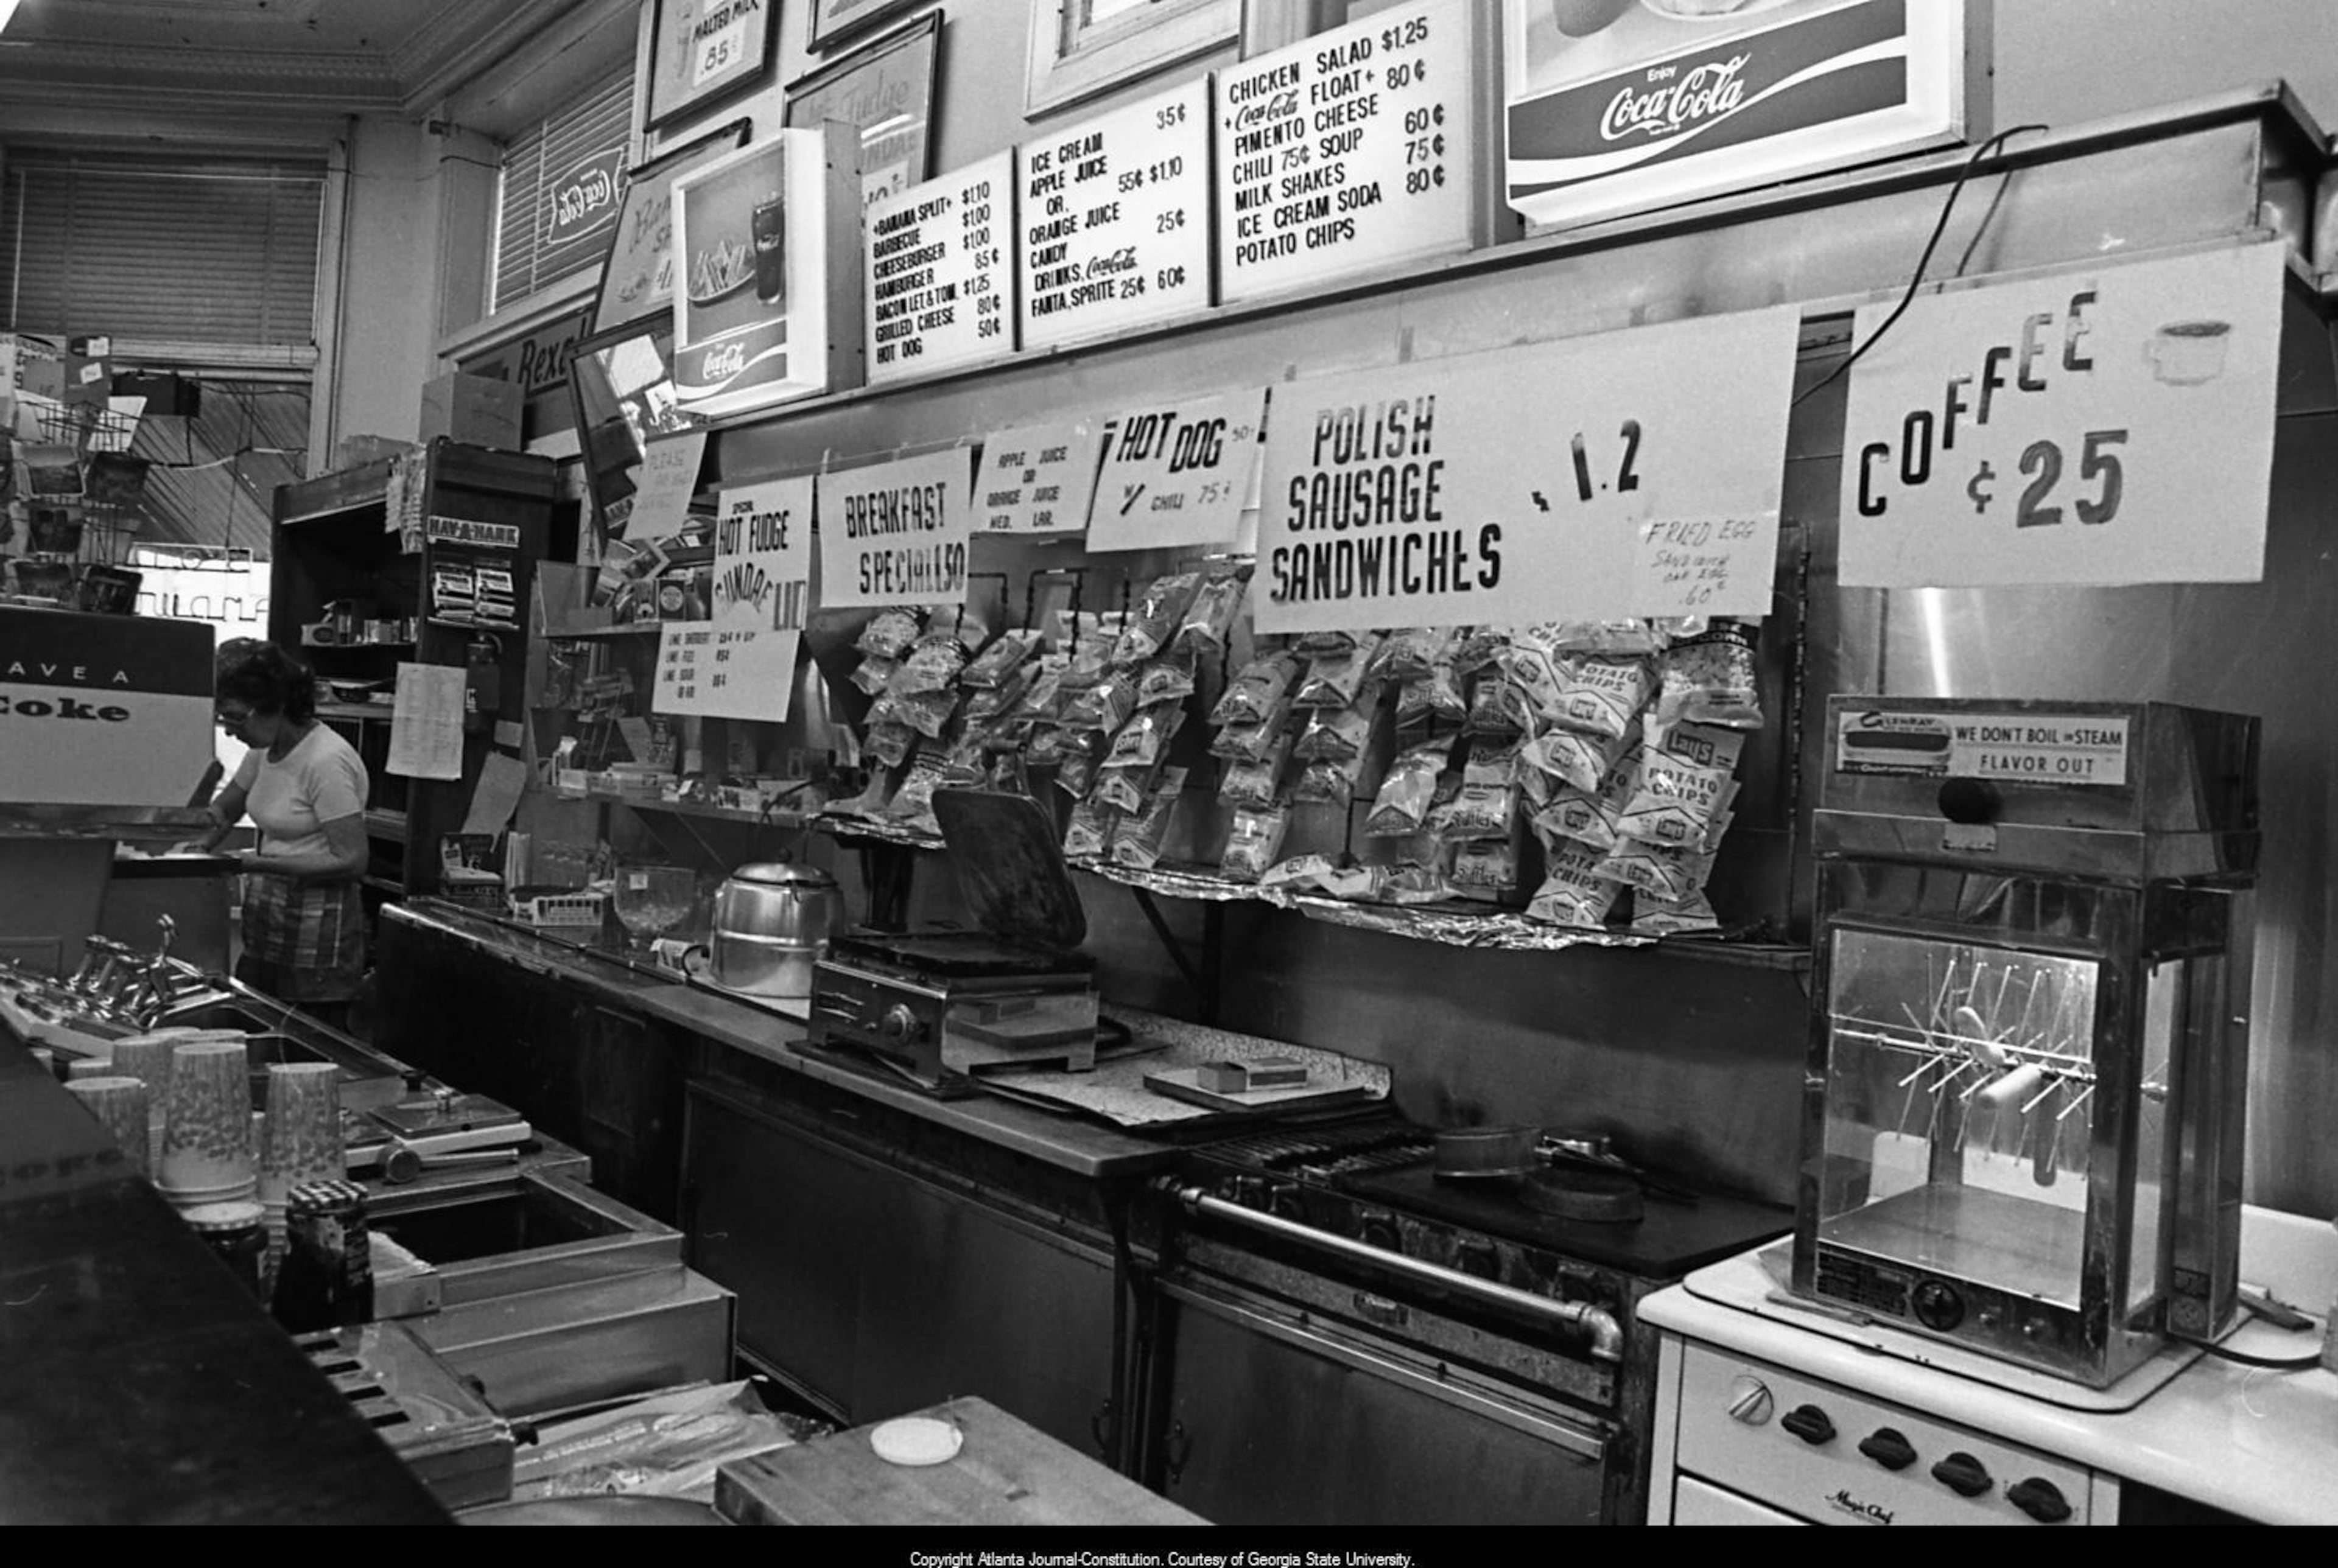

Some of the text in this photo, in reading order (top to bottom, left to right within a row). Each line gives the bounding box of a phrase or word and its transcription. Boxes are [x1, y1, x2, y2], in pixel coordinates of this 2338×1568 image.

[1230, 16, 1428, 104] CHICKEN SALAD $1.25
[1648, 66, 1676, 82] Enjoy
[1311, 69, 1363, 105] FLOAT
[1600, 52, 1752, 141] Coca-Cola
[1234, 93, 1378, 157] PIMENTO CHEESE
[1031, 151, 1051, 174] ICE
[1059, 131, 1103, 163] CREAM
[1233, 155, 1273, 185] CHILI
[1320, 127, 1363, 159] SOUP
[1030, 155, 1108, 198] APPLE JUICE
[1235, 183, 1272, 212] MILK
[1282, 162, 1346, 199] SHAKES
[918, 197, 945, 221] SPLIT
[1030, 201, 1120, 245] ORANGE JUICE
[1238, 214, 1262, 239] ICE
[1274, 195, 1330, 229] CREAM
[1337, 181, 1382, 212] SODA
[874, 228, 921, 259] BARBECUE
[1031, 242, 1069, 269] CANDY
[1237, 217, 1355, 267] POTATO CHIPS
[874, 242, 946, 280] CHEESEBURGER
[875, 268, 934, 301] HAMBURGER
[876, 298, 907, 322] BACON
[876, 318, 912, 343] GRILLED
[918, 306, 954, 331] CHEESE
[877, 345, 895, 364] HOT
[902, 337, 922, 358] DOG
[1858, 289, 2099, 517] COFFEE
[1115, 411, 1178, 463] HOT
[1168, 417, 1227, 473] DOG
[1313, 394, 1436, 467] POLISH
[998, 445, 1068, 469] APPLE JUICE
[1022, 468, 1036, 485] OR
[846, 483, 947, 538] BREAKFAST
[987, 485, 1061, 508] ORANGE JUICE
[1151, 492, 1184, 512] CHILI
[1288, 459, 1444, 533] SAUSAGE
[718, 510, 790, 556] HOT FUDGE
[1645, 519, 1756, 547] FRIED EGG
[1269, 522, 1503, 603] SANDWICHES
[714, 562, 773, 613] SUNDAE
[9, 661, 129, 684] AVE A
[1584, 675, 1626, 692] HIPS
[1586, 666, 1638, 683] OTATO
[1956, 727, 1976, 741] WE
[2027, 728, 2059, 743] BOIL
[1649, 767, 1718, 794] POTATO
[1981, 755, 2094, 773] FLAVOR OUT
[1557, 853, 1596, 871] POTA
